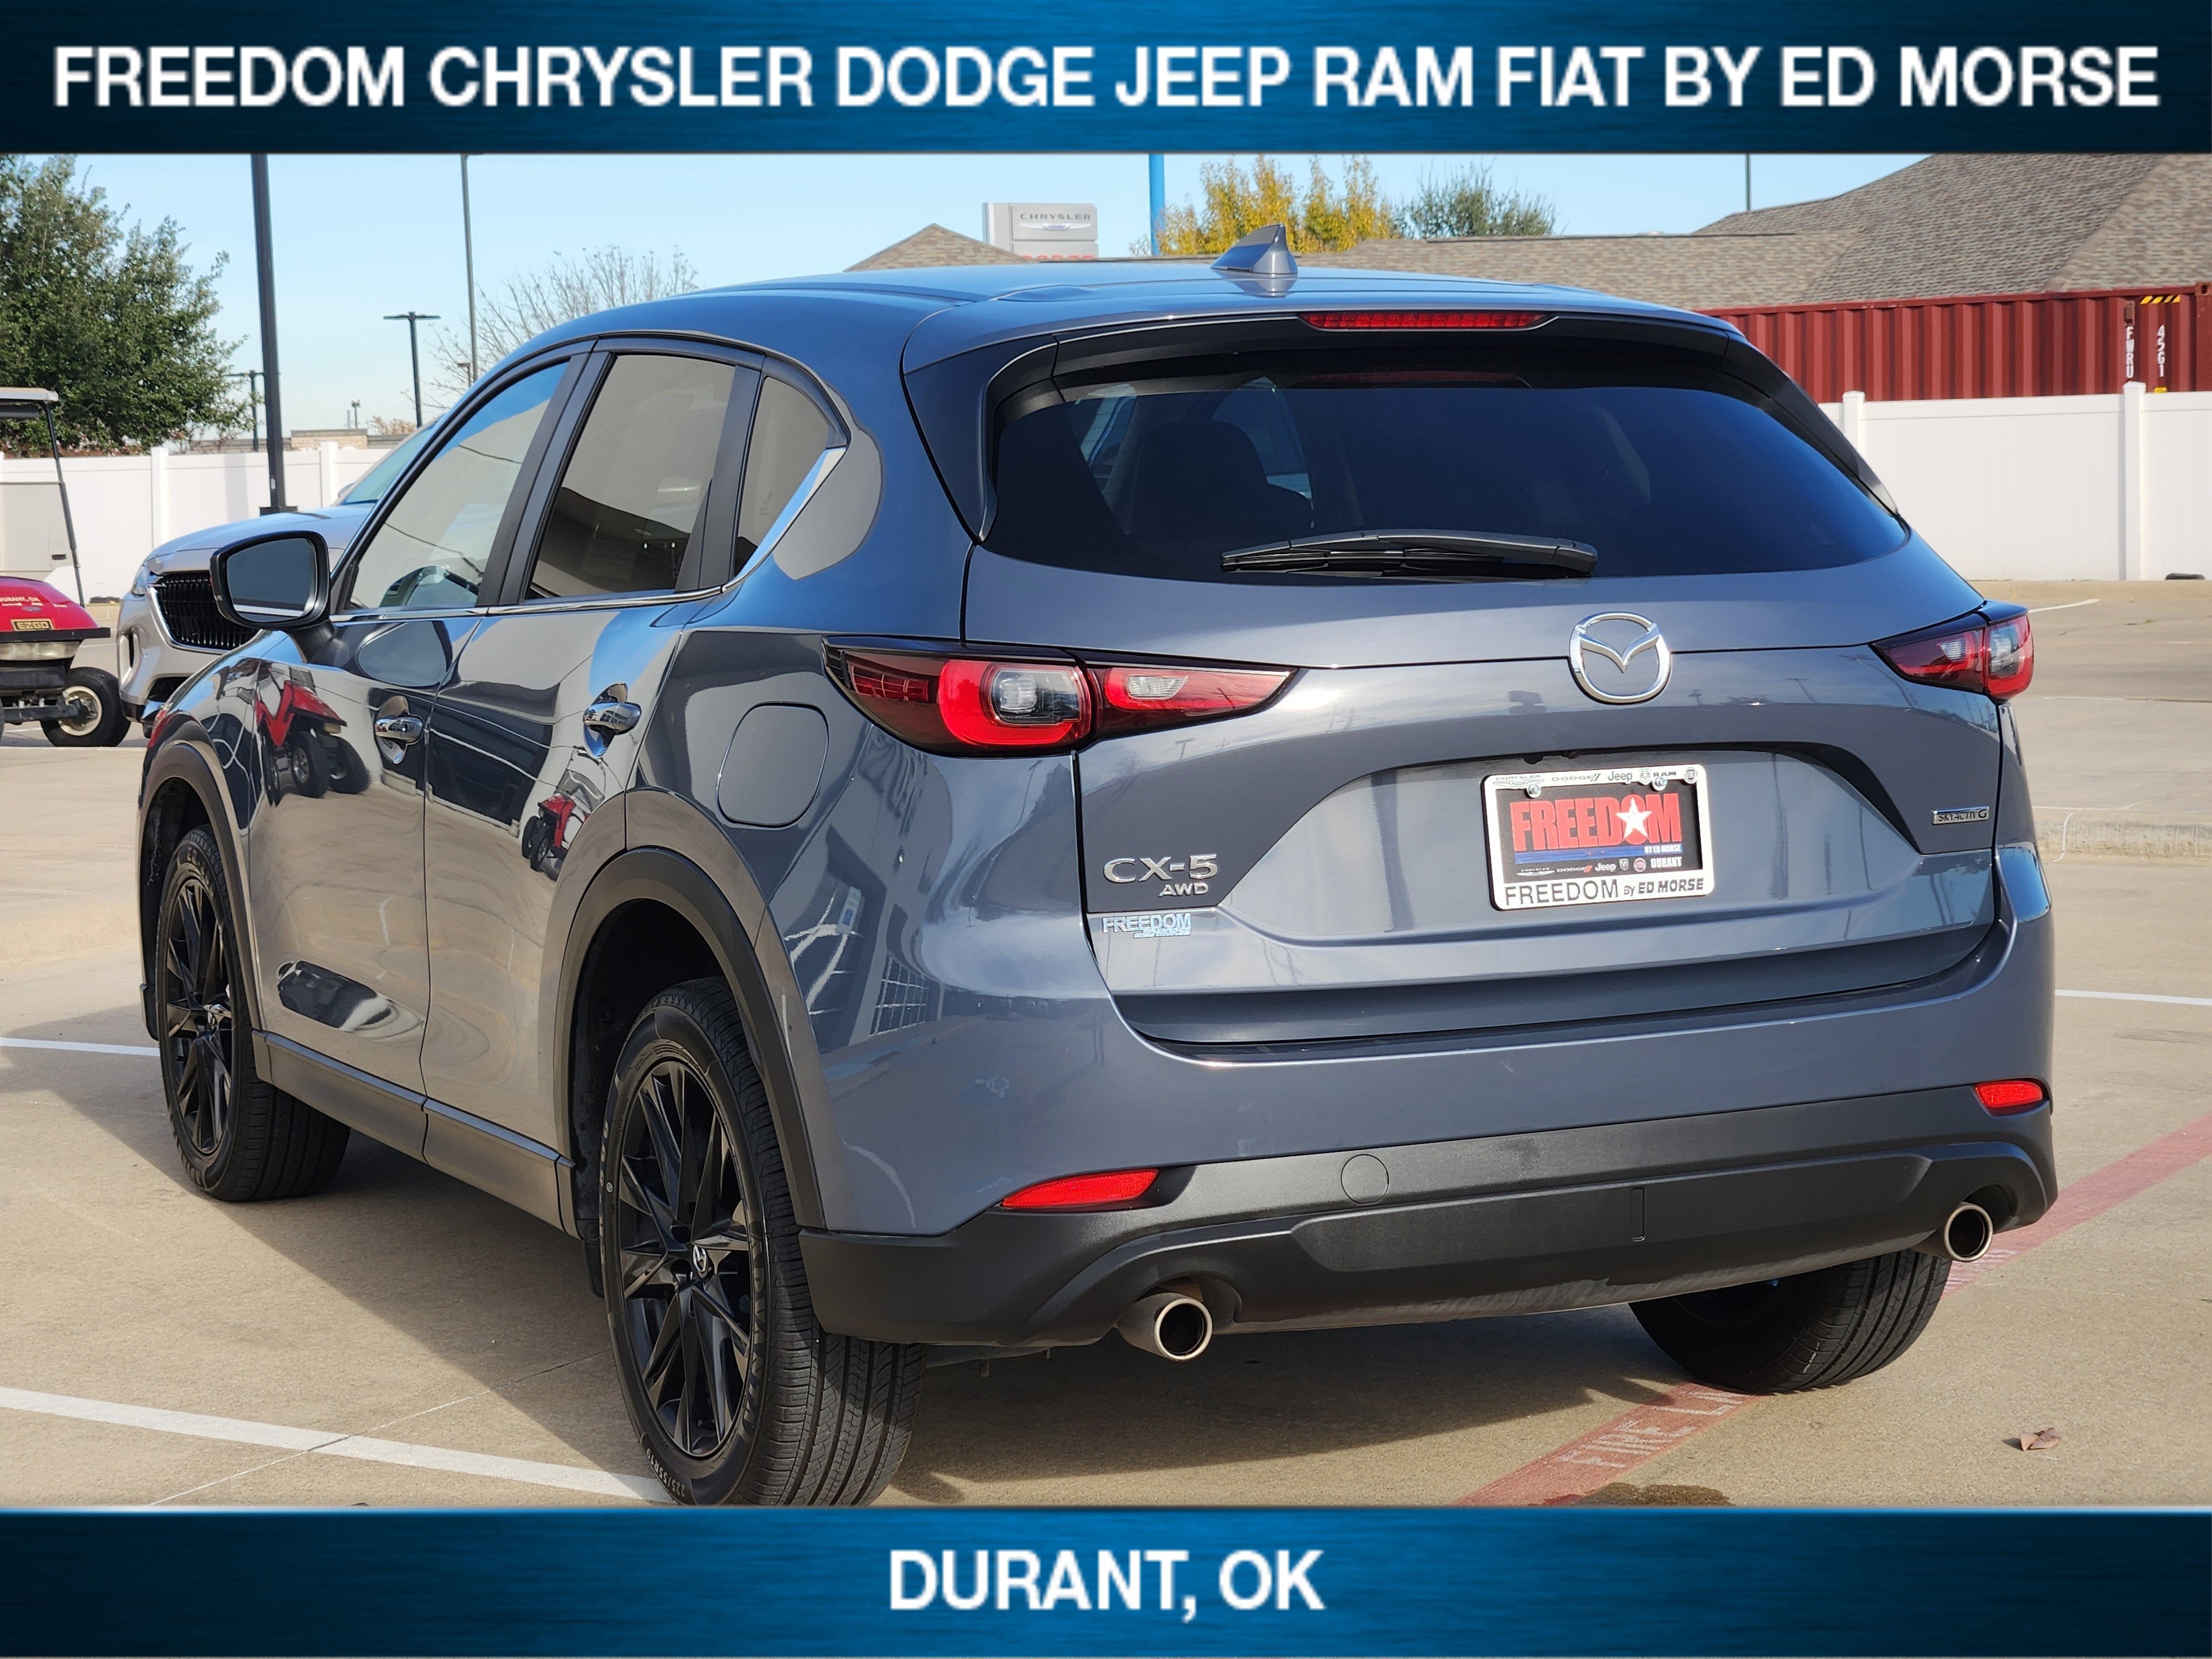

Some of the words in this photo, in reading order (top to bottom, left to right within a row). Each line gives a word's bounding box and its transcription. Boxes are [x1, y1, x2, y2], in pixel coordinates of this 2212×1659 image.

[1608, 771, 1632, 782] Jeep
[1510, 792, 1682, 851] FREEDOM
[1978, 809, 1987, 818] G
[1103, 853, 1218, 884] CX-5
[1595, 863, 1617, 872] Jeep
[1651, 857, 1682, 868] DURANT
[1158, 882, 1209, 898] AWD
[1505, 878, 1619, 906] FREEDOM
[1638, 881, 1655, 895] ED
[1657, 877, 1704, 893] MORSE
[1102, 913, 1192, 933] FREEDOM
